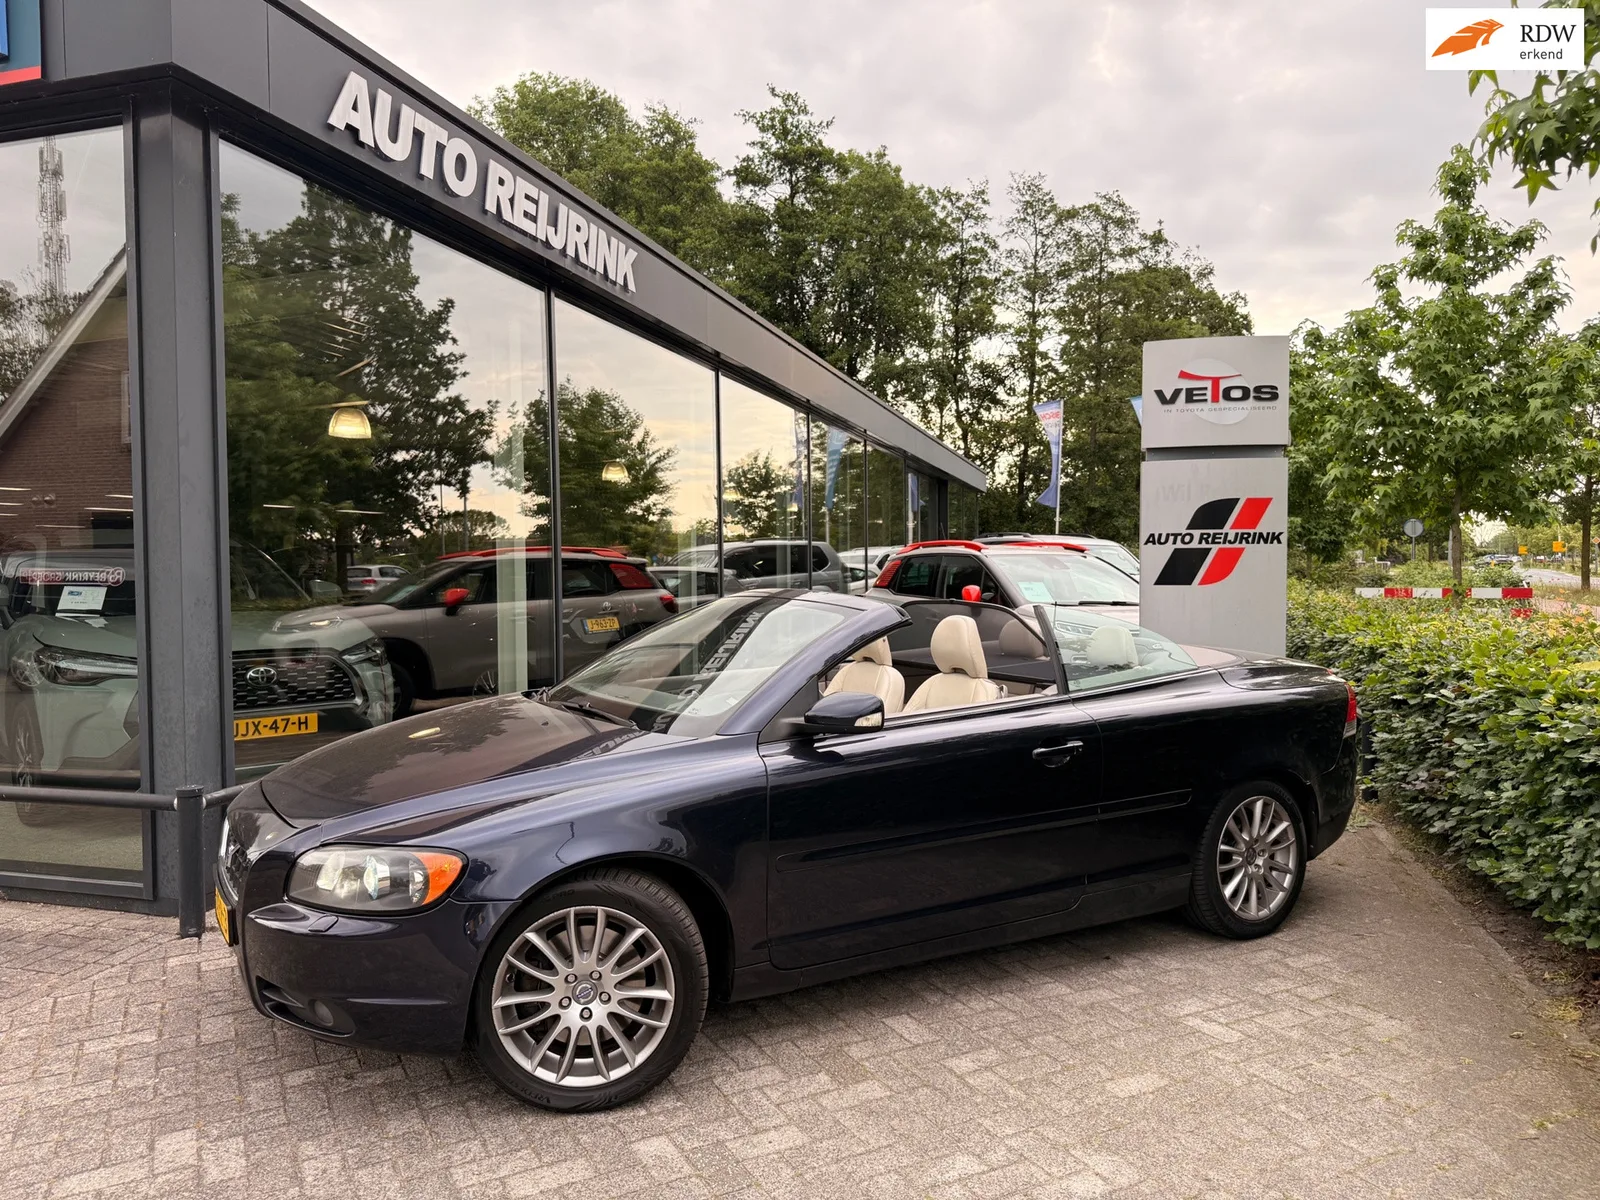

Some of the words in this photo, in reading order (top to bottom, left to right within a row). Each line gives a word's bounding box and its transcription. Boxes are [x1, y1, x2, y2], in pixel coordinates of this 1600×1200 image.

[326, 71, 478, 197] AUTO
[484, 158, 638, 293] REIJRINK
[1153, 370, 1280, 406] VETOS
[1143, 532, 1195, 546] AUTO
[1197, 531, 1284, 545] REIJRINK
